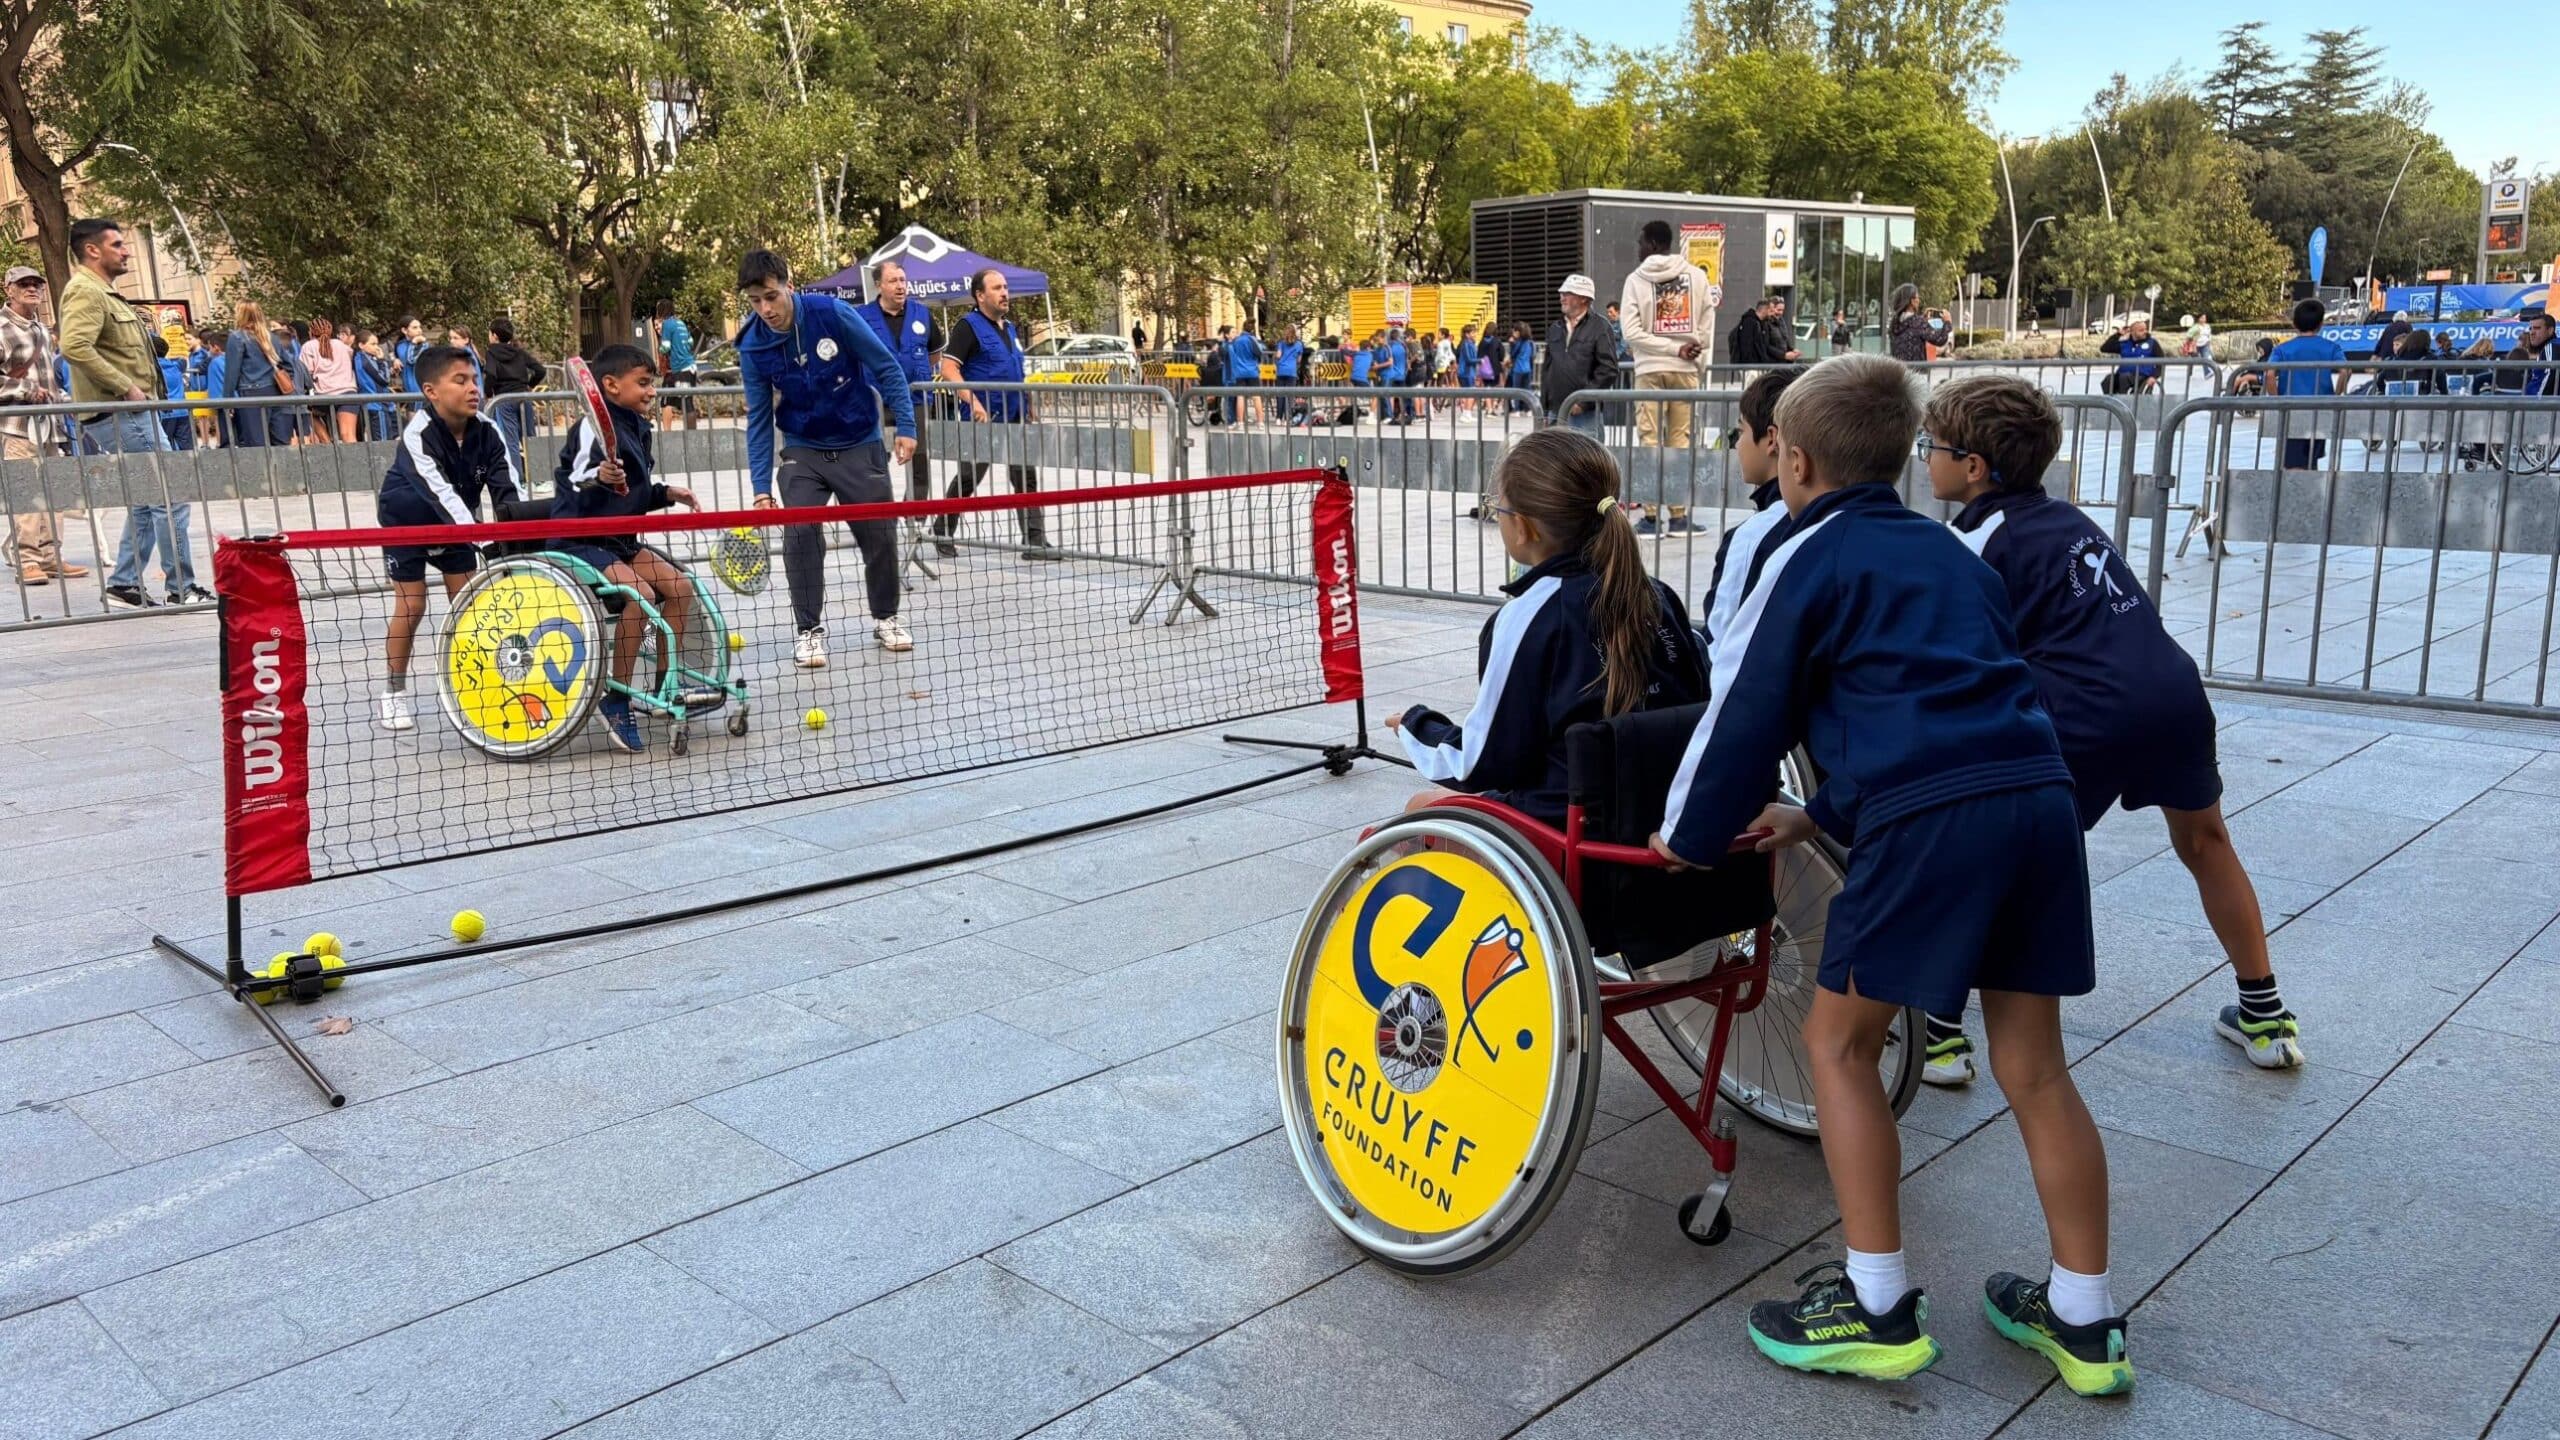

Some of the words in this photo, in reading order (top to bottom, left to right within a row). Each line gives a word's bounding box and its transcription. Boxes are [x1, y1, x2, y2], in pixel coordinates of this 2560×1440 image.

[906, 280, 947, 298] Aigües
[950, 281, 960, 291] de
[2446, 326, 2529, 340] OLYMPIC
[1328, 537, 1353, 638] Wilson
[466, 592, 524, 690] CRUYFF
[241, 638, 285, 791] Wilson
[1323, 1101, 1453, 1213] FOUNDATION
[1325, 1047, 1477, 1177] CRUYFF
[1805, 1320, 1870, 1341] KIPRUN
